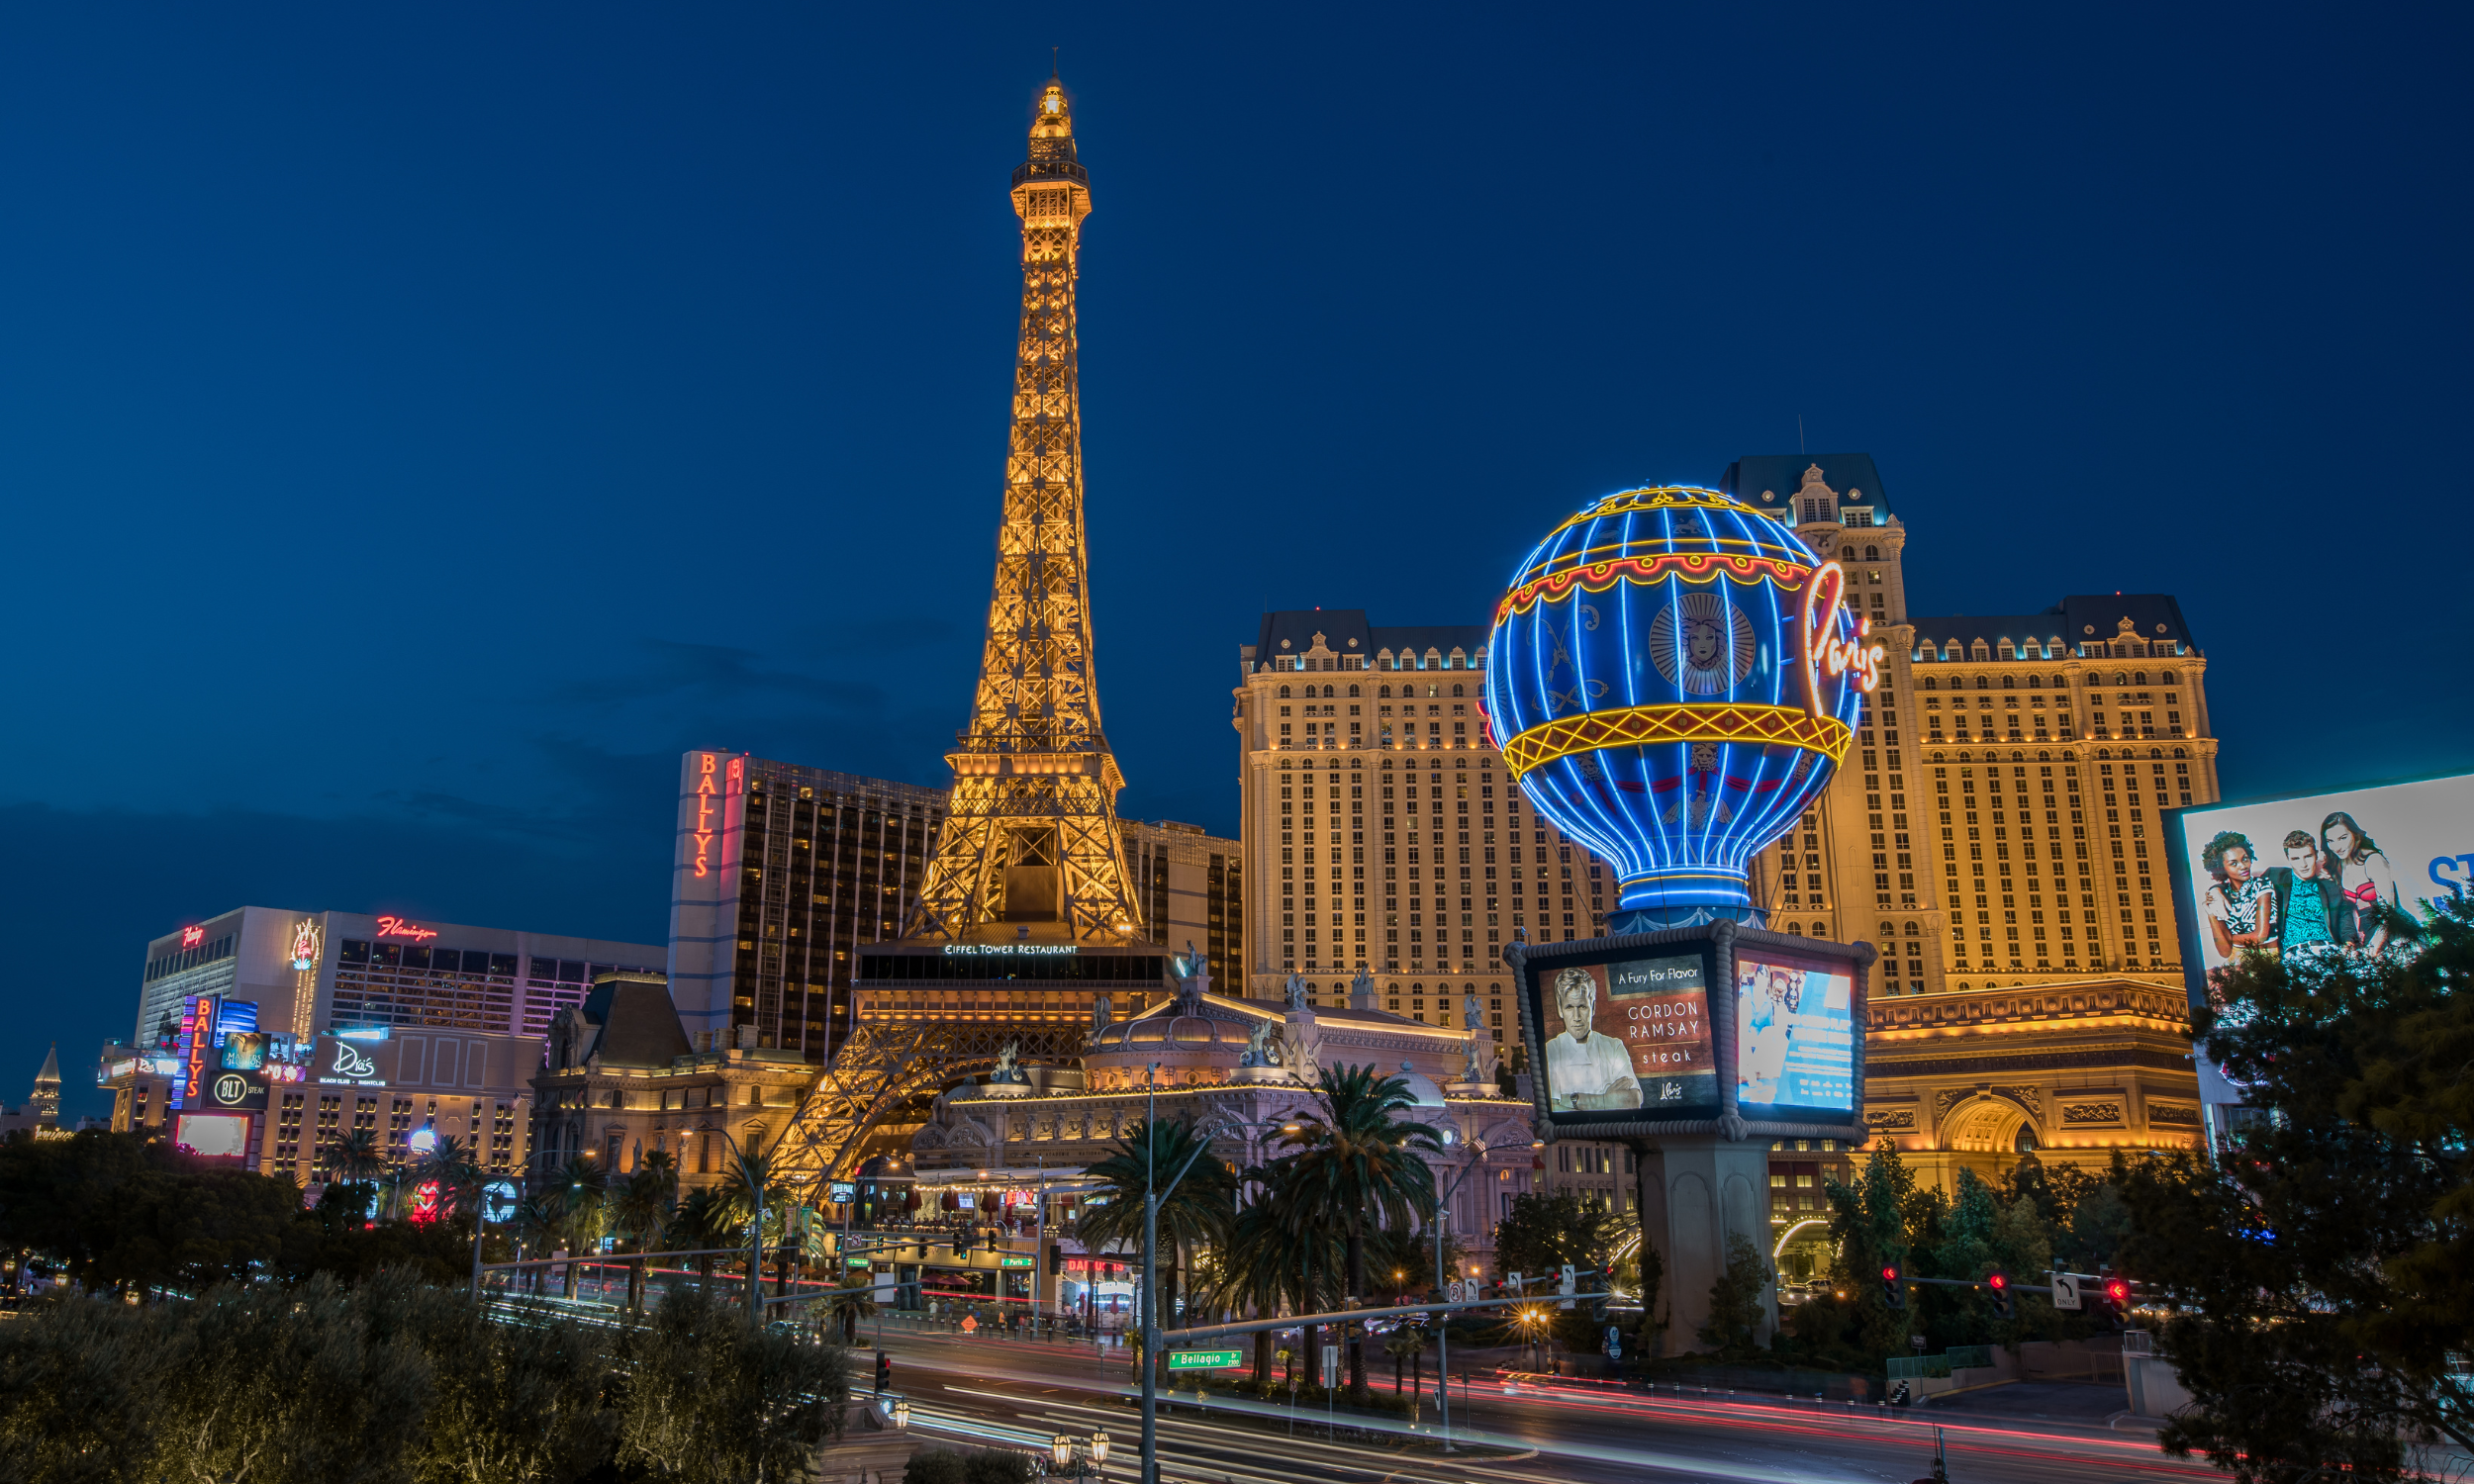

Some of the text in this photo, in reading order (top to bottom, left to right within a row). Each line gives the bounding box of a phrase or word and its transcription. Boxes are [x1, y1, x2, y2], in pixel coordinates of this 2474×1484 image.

[1799, 561, 1883, 718] Paris
[377, 916, 437, 941] Flamingo
[945, 944, 1078, 955] EIFFEL TOWER RESTAURANT
[1618, 968, 1698, 984] A Fury For Flavor
[1628, 1001, 1698, 1020] GORDON
[1630, 1020, 1698, 1039] RAMSAY
[1643, 1050, 1691, 1065] steak
[222, 1080, 240, 1098] BLT
[1182, 1353, 1220, 1365] Bellagio
